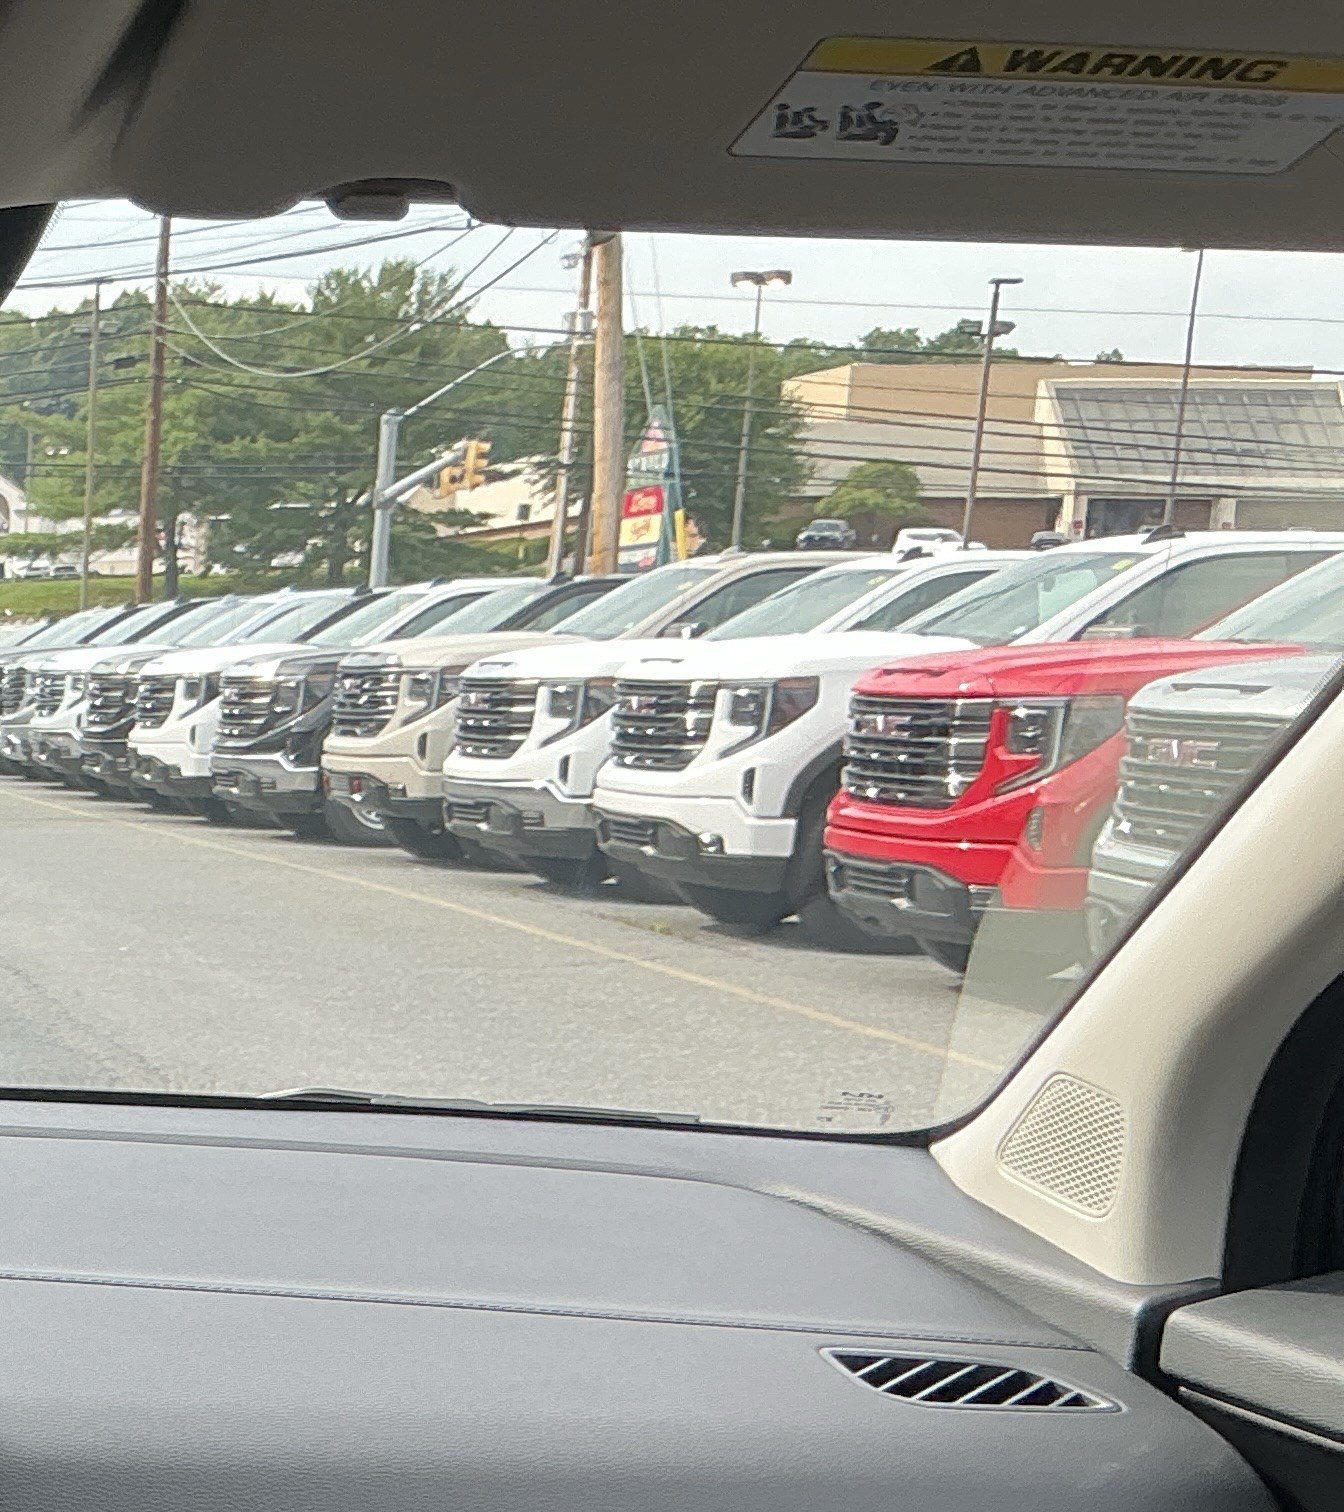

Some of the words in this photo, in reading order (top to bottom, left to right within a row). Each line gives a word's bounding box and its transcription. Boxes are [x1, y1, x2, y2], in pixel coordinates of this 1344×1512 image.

[1002, 50, 1289, 83] WARNING
[869, 79, 942, 94] EVEN
[947, 82, 1018, 96] WITH
[1023, 84, 1161, 103] ADVANCED
